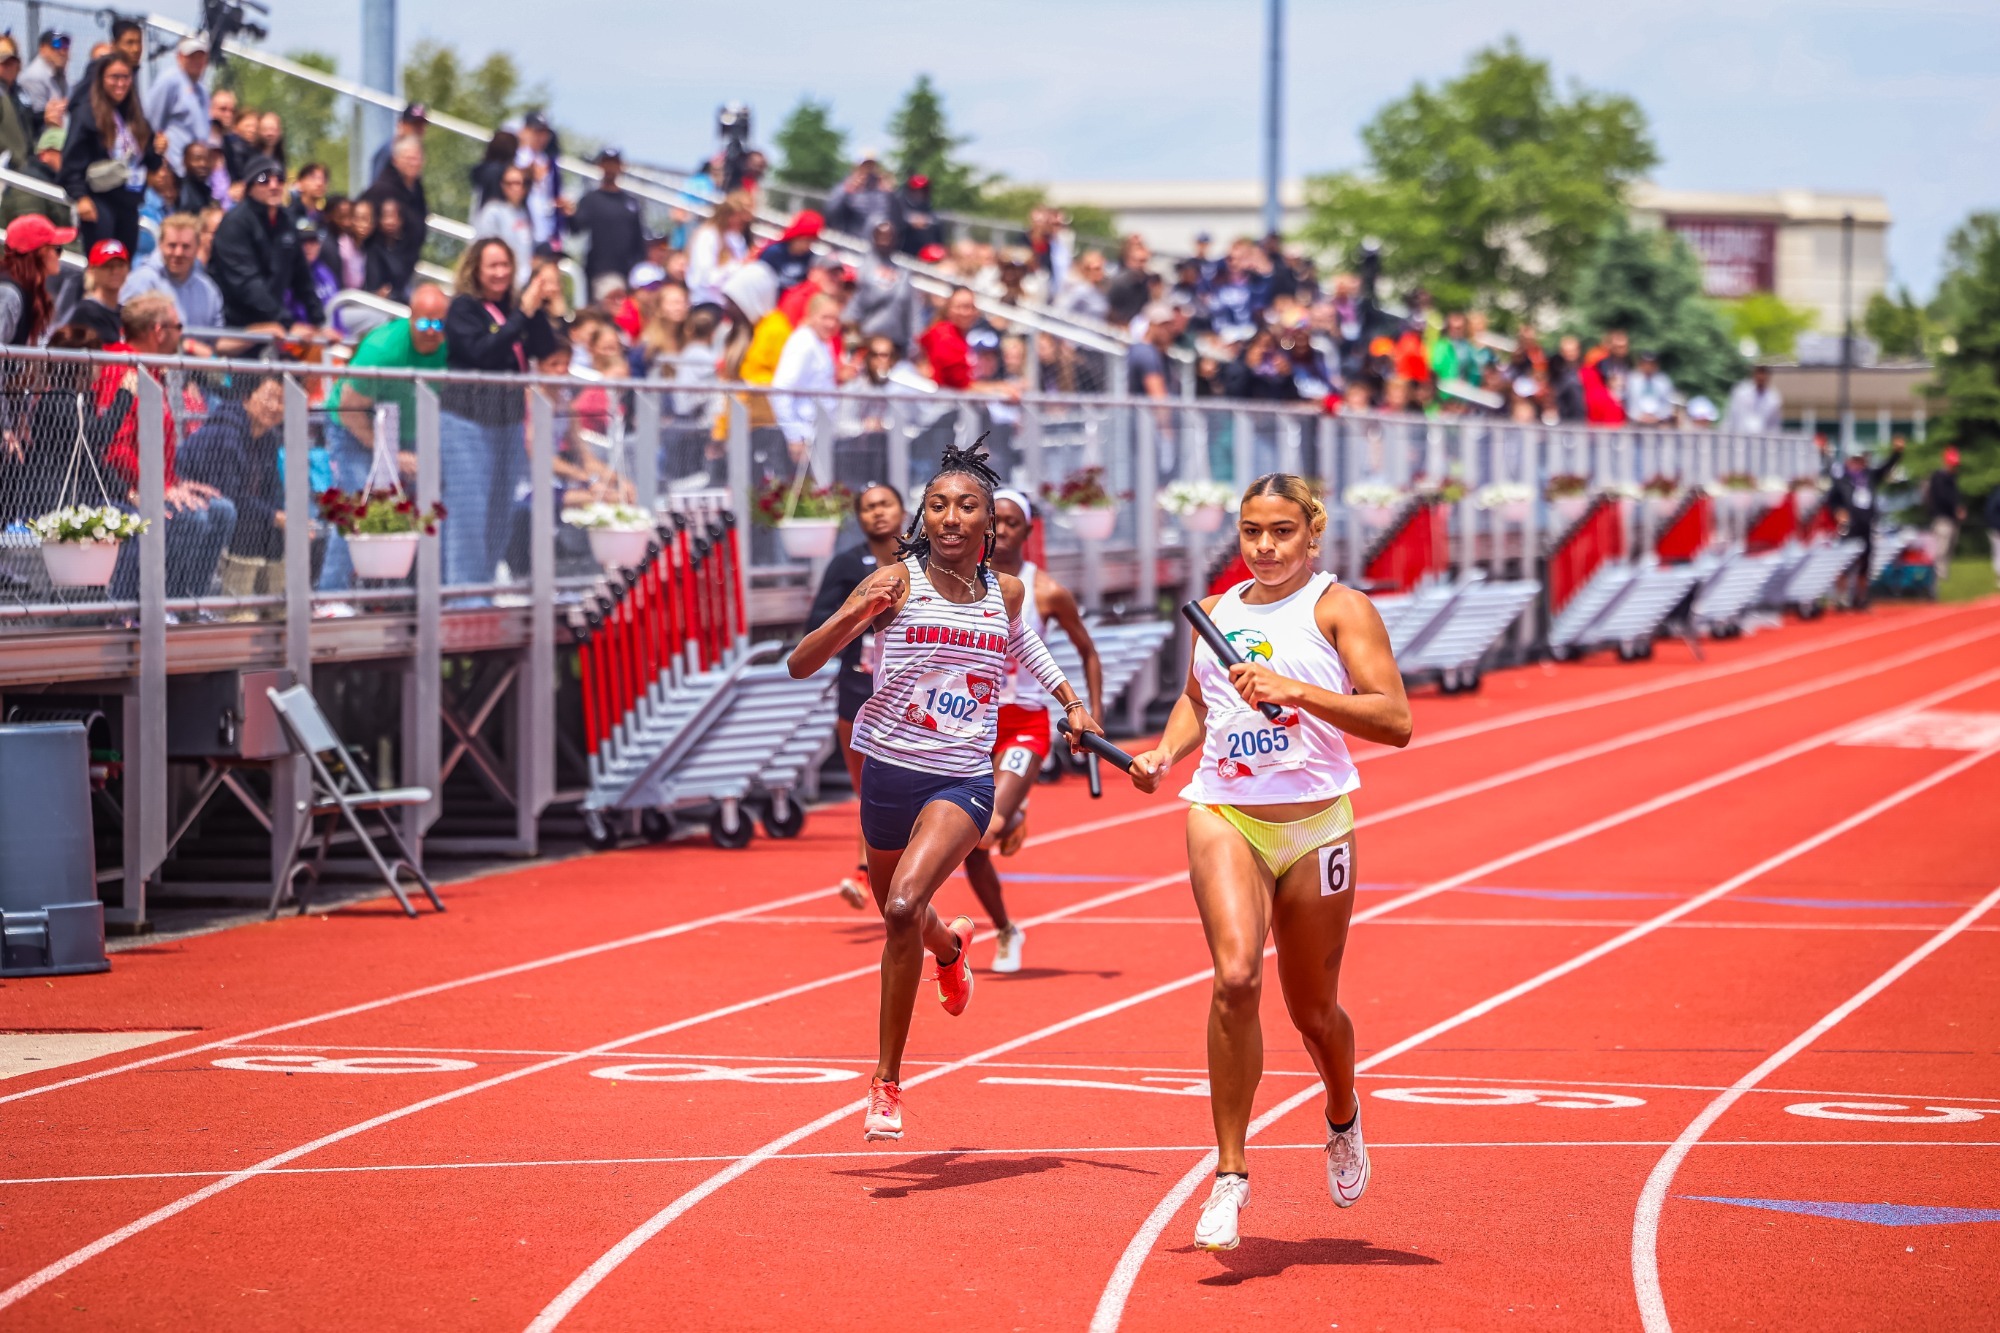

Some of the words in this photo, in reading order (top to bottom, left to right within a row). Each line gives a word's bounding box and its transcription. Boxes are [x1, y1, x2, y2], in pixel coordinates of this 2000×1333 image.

[926, 688, 978, 722] 1902
[1227, 726, 1289, 759] 2065
[1008, 750, 1024, 770] 8
[1328, 847, 1345, 892] 6
[210, 1055, 479, 1074] 9
[589, 1063, 865, 1084] 8
[1370, 1086, 1648, 1109] 6
